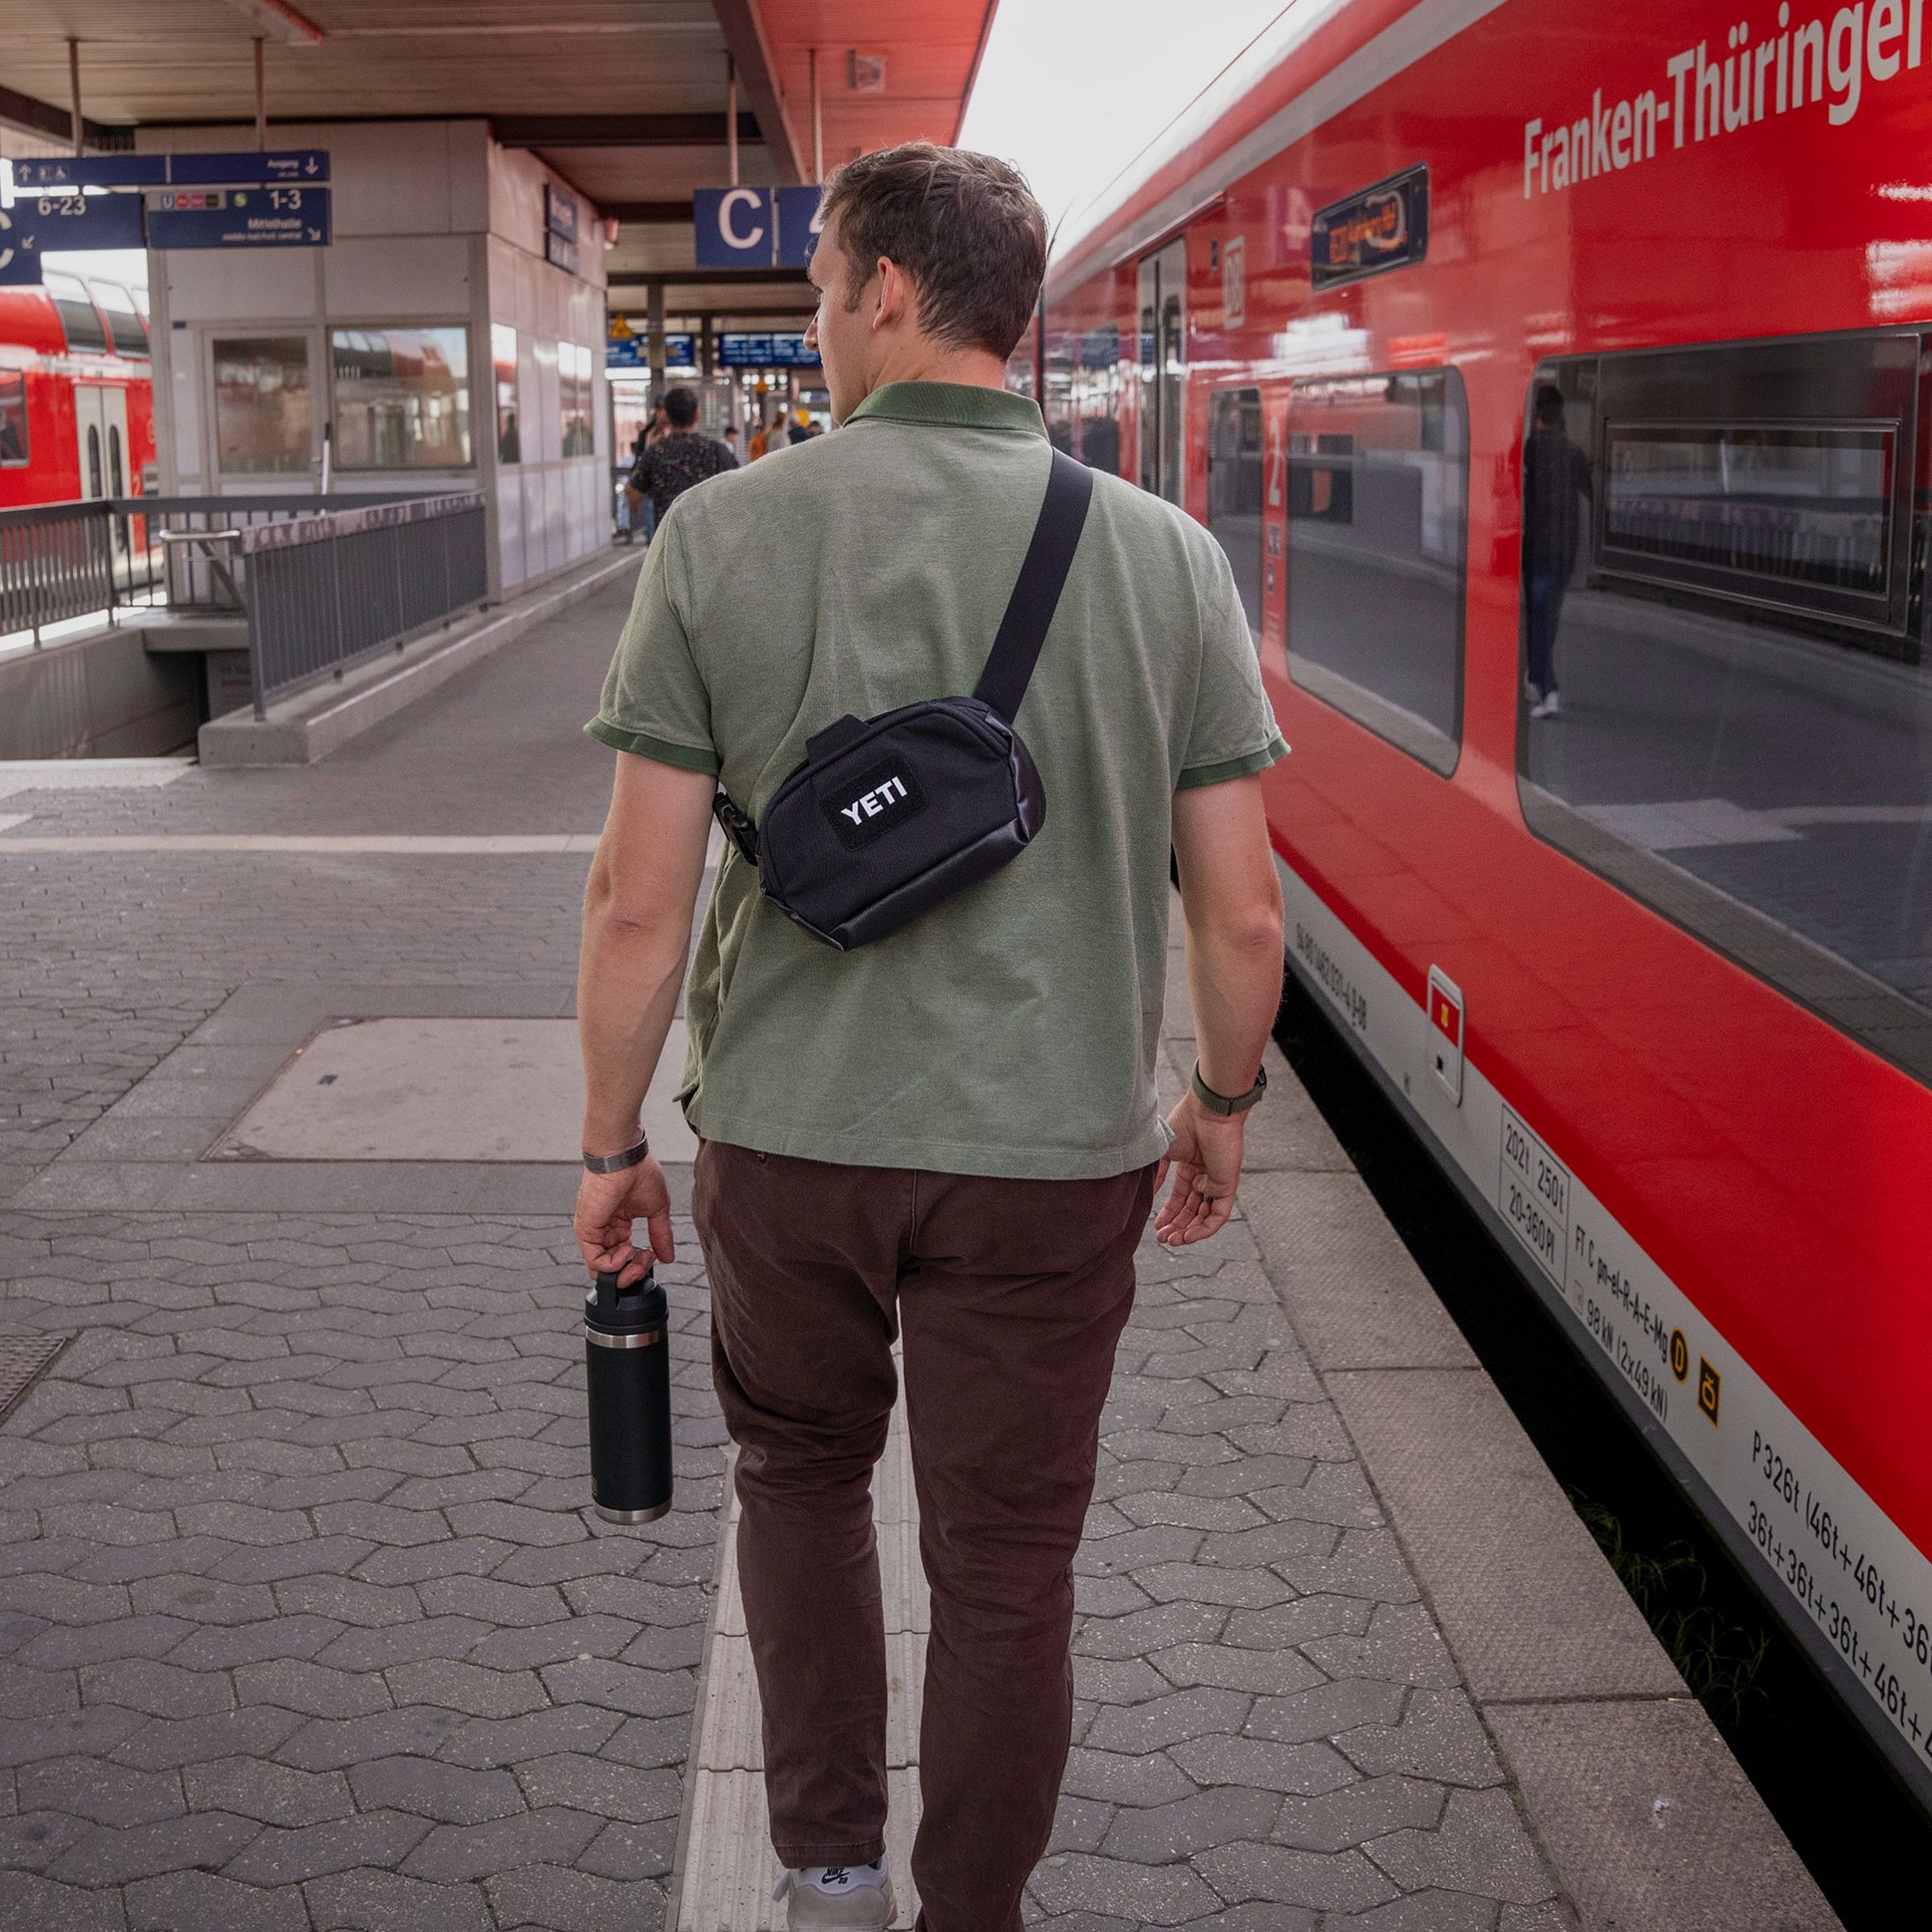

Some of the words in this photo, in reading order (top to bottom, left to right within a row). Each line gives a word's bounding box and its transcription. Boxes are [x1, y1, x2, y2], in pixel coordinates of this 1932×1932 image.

[38, 195, 86, 216] 6-23
[270, 189, 302, 210] 1-3
[718, 189, 763, 249] C
[840, 775, 908, 825] YETI
[1538, 1158, 1564, 1215] 250t
[1806, 1491, 1932, 1676] (46t+46t+36
[826, 1867, 845, 1878] NIKE
